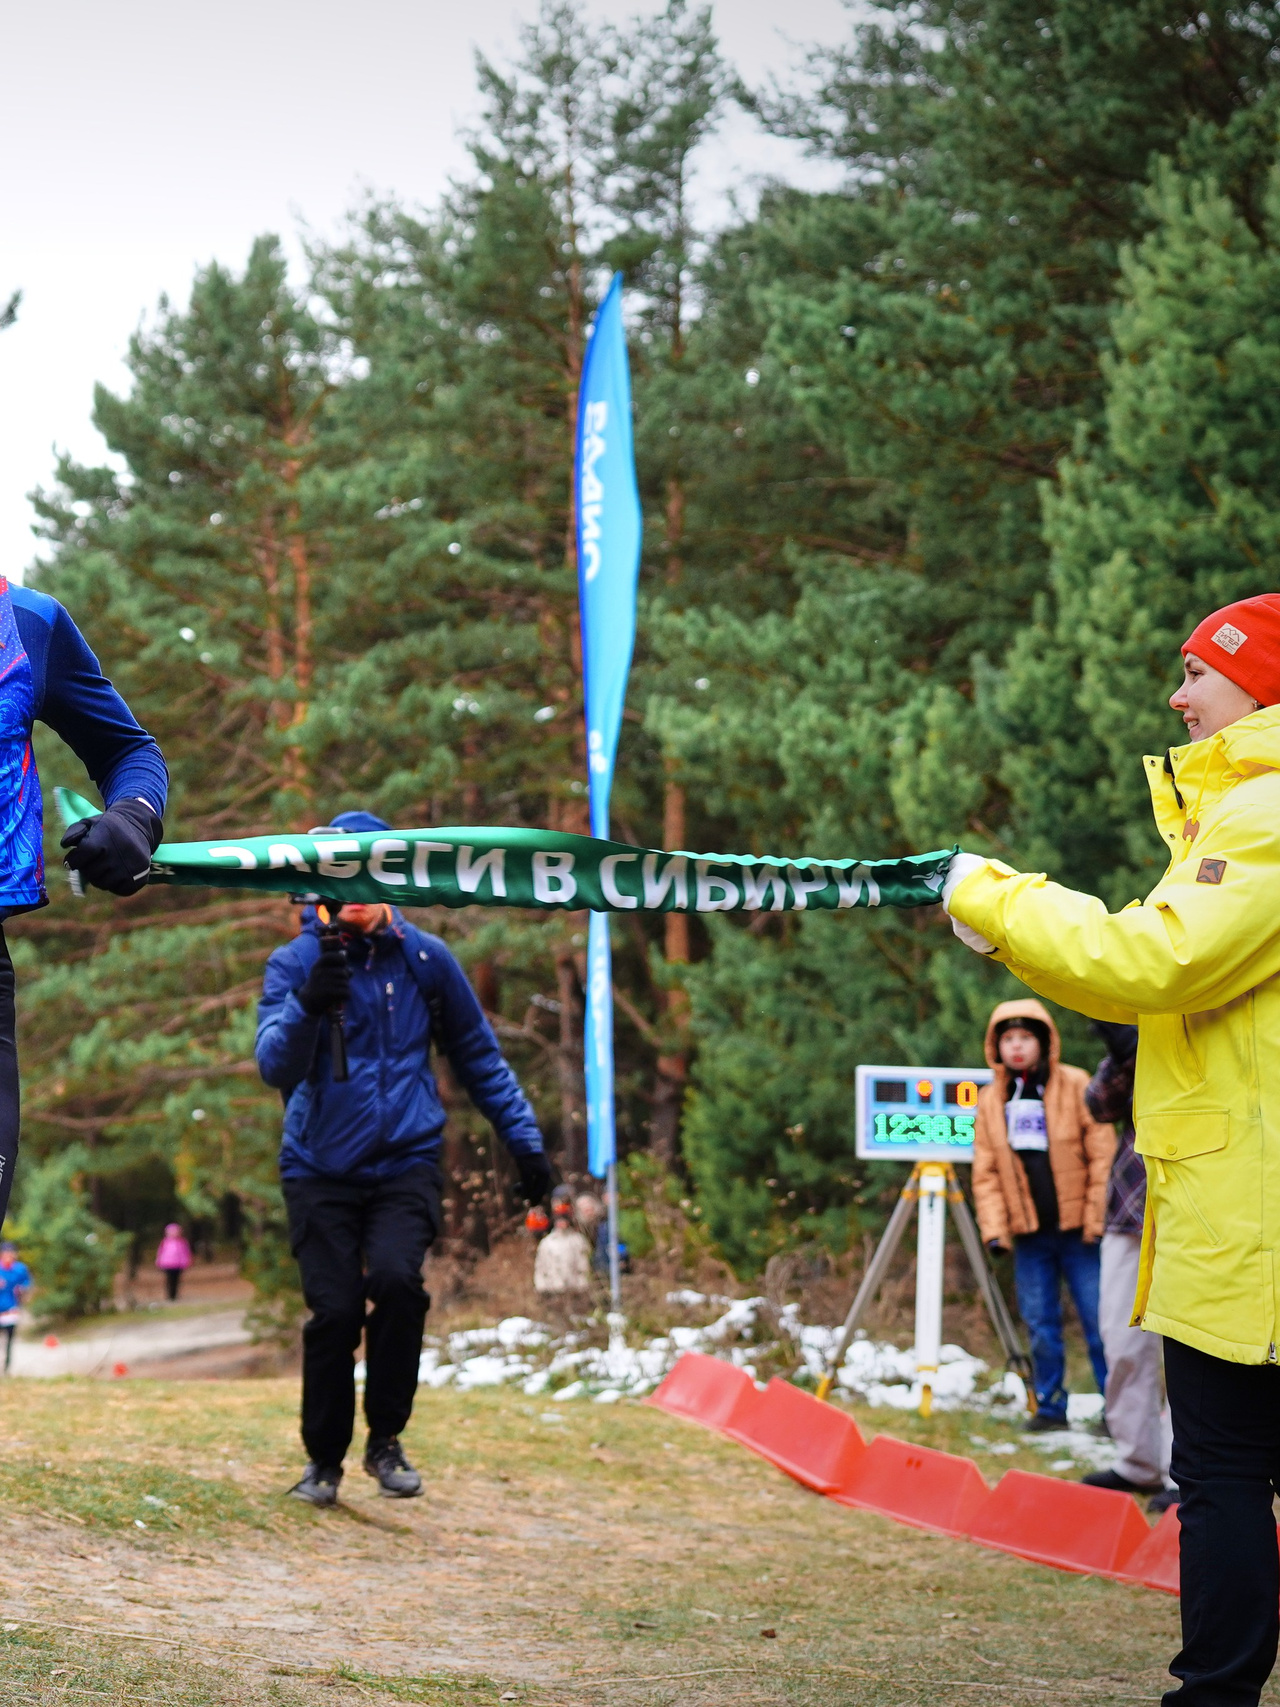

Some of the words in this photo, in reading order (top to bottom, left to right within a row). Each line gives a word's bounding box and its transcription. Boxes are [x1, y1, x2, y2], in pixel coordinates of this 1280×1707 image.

[532, 851, 578, 904] В
[598, 851, 882, 911] СИБИРИ
[874, 1113, 976, 1145] 12:38.5
